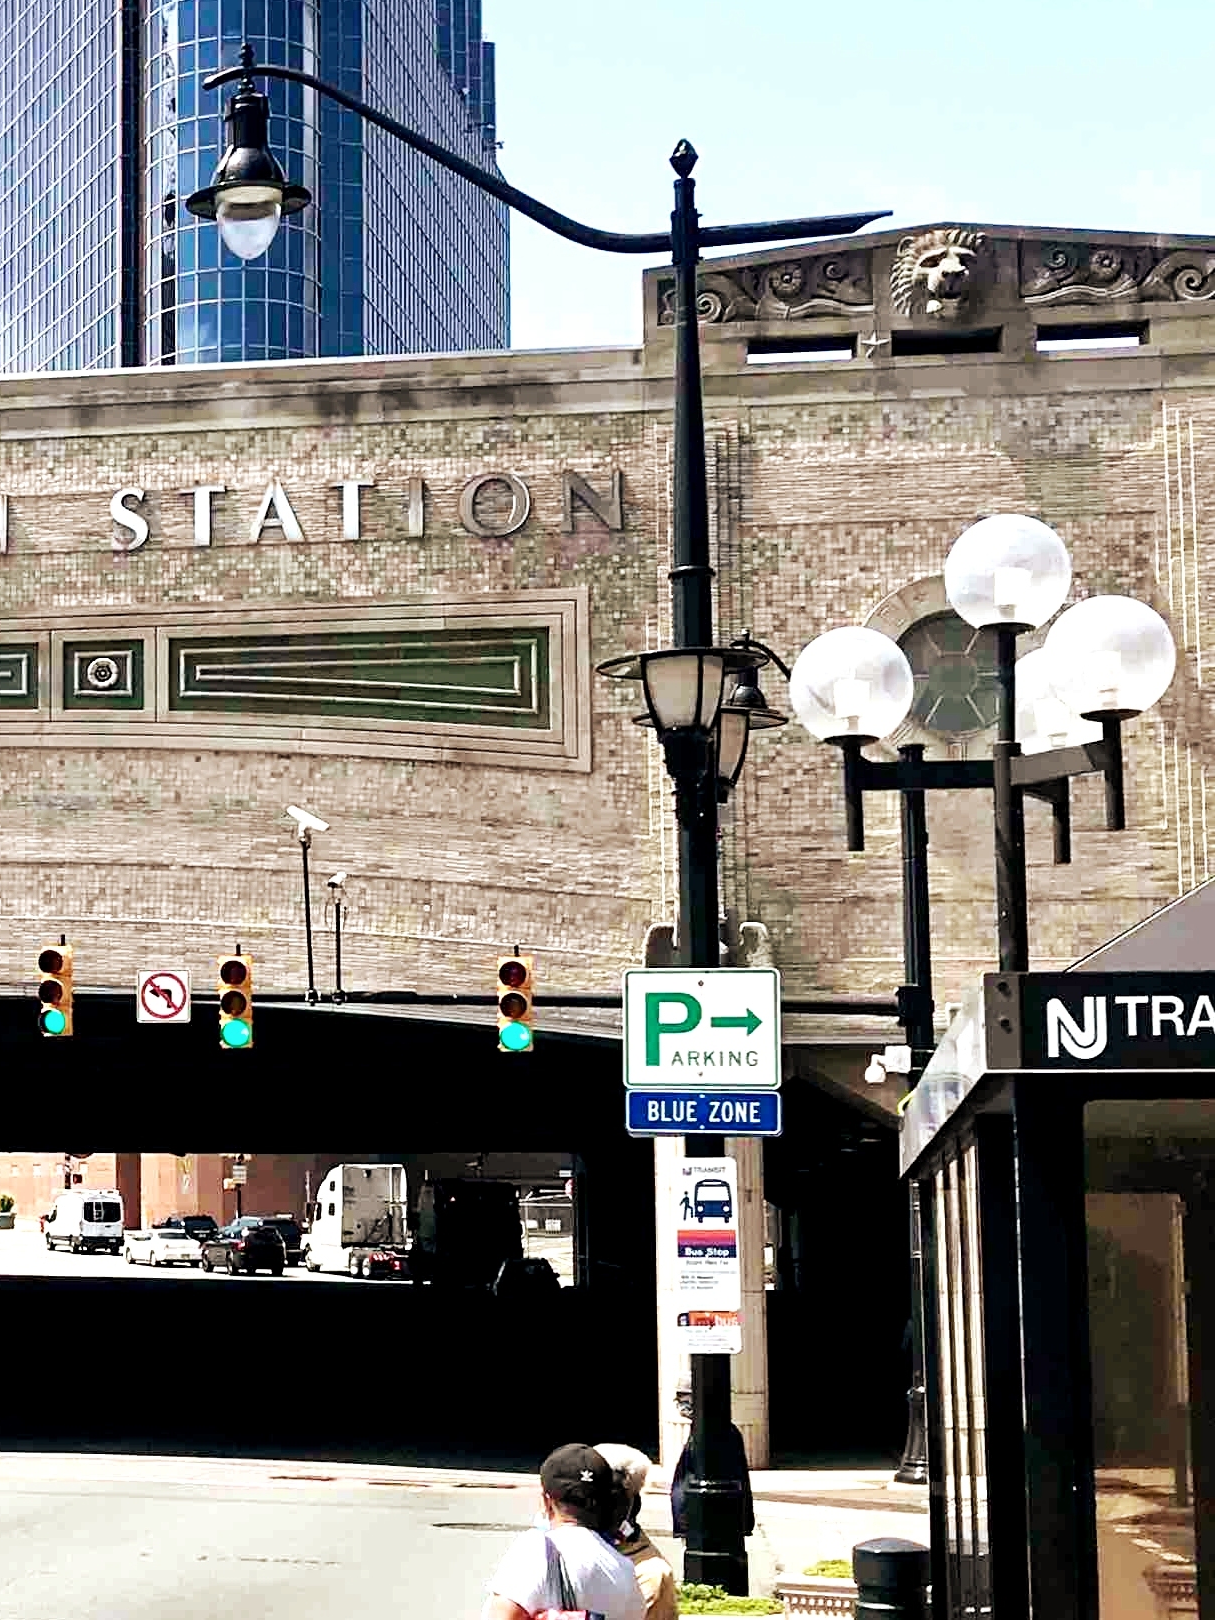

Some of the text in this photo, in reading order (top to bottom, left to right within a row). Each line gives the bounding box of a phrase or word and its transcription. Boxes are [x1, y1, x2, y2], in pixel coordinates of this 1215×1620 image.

[108, 468, 626, 553] STATION
[1046, 994, 1215, 1060] NJ TRA
[647, 1100, 761, 1123] BLUE ZONE
[685, 1247, 730, 1258] Bus Stop
